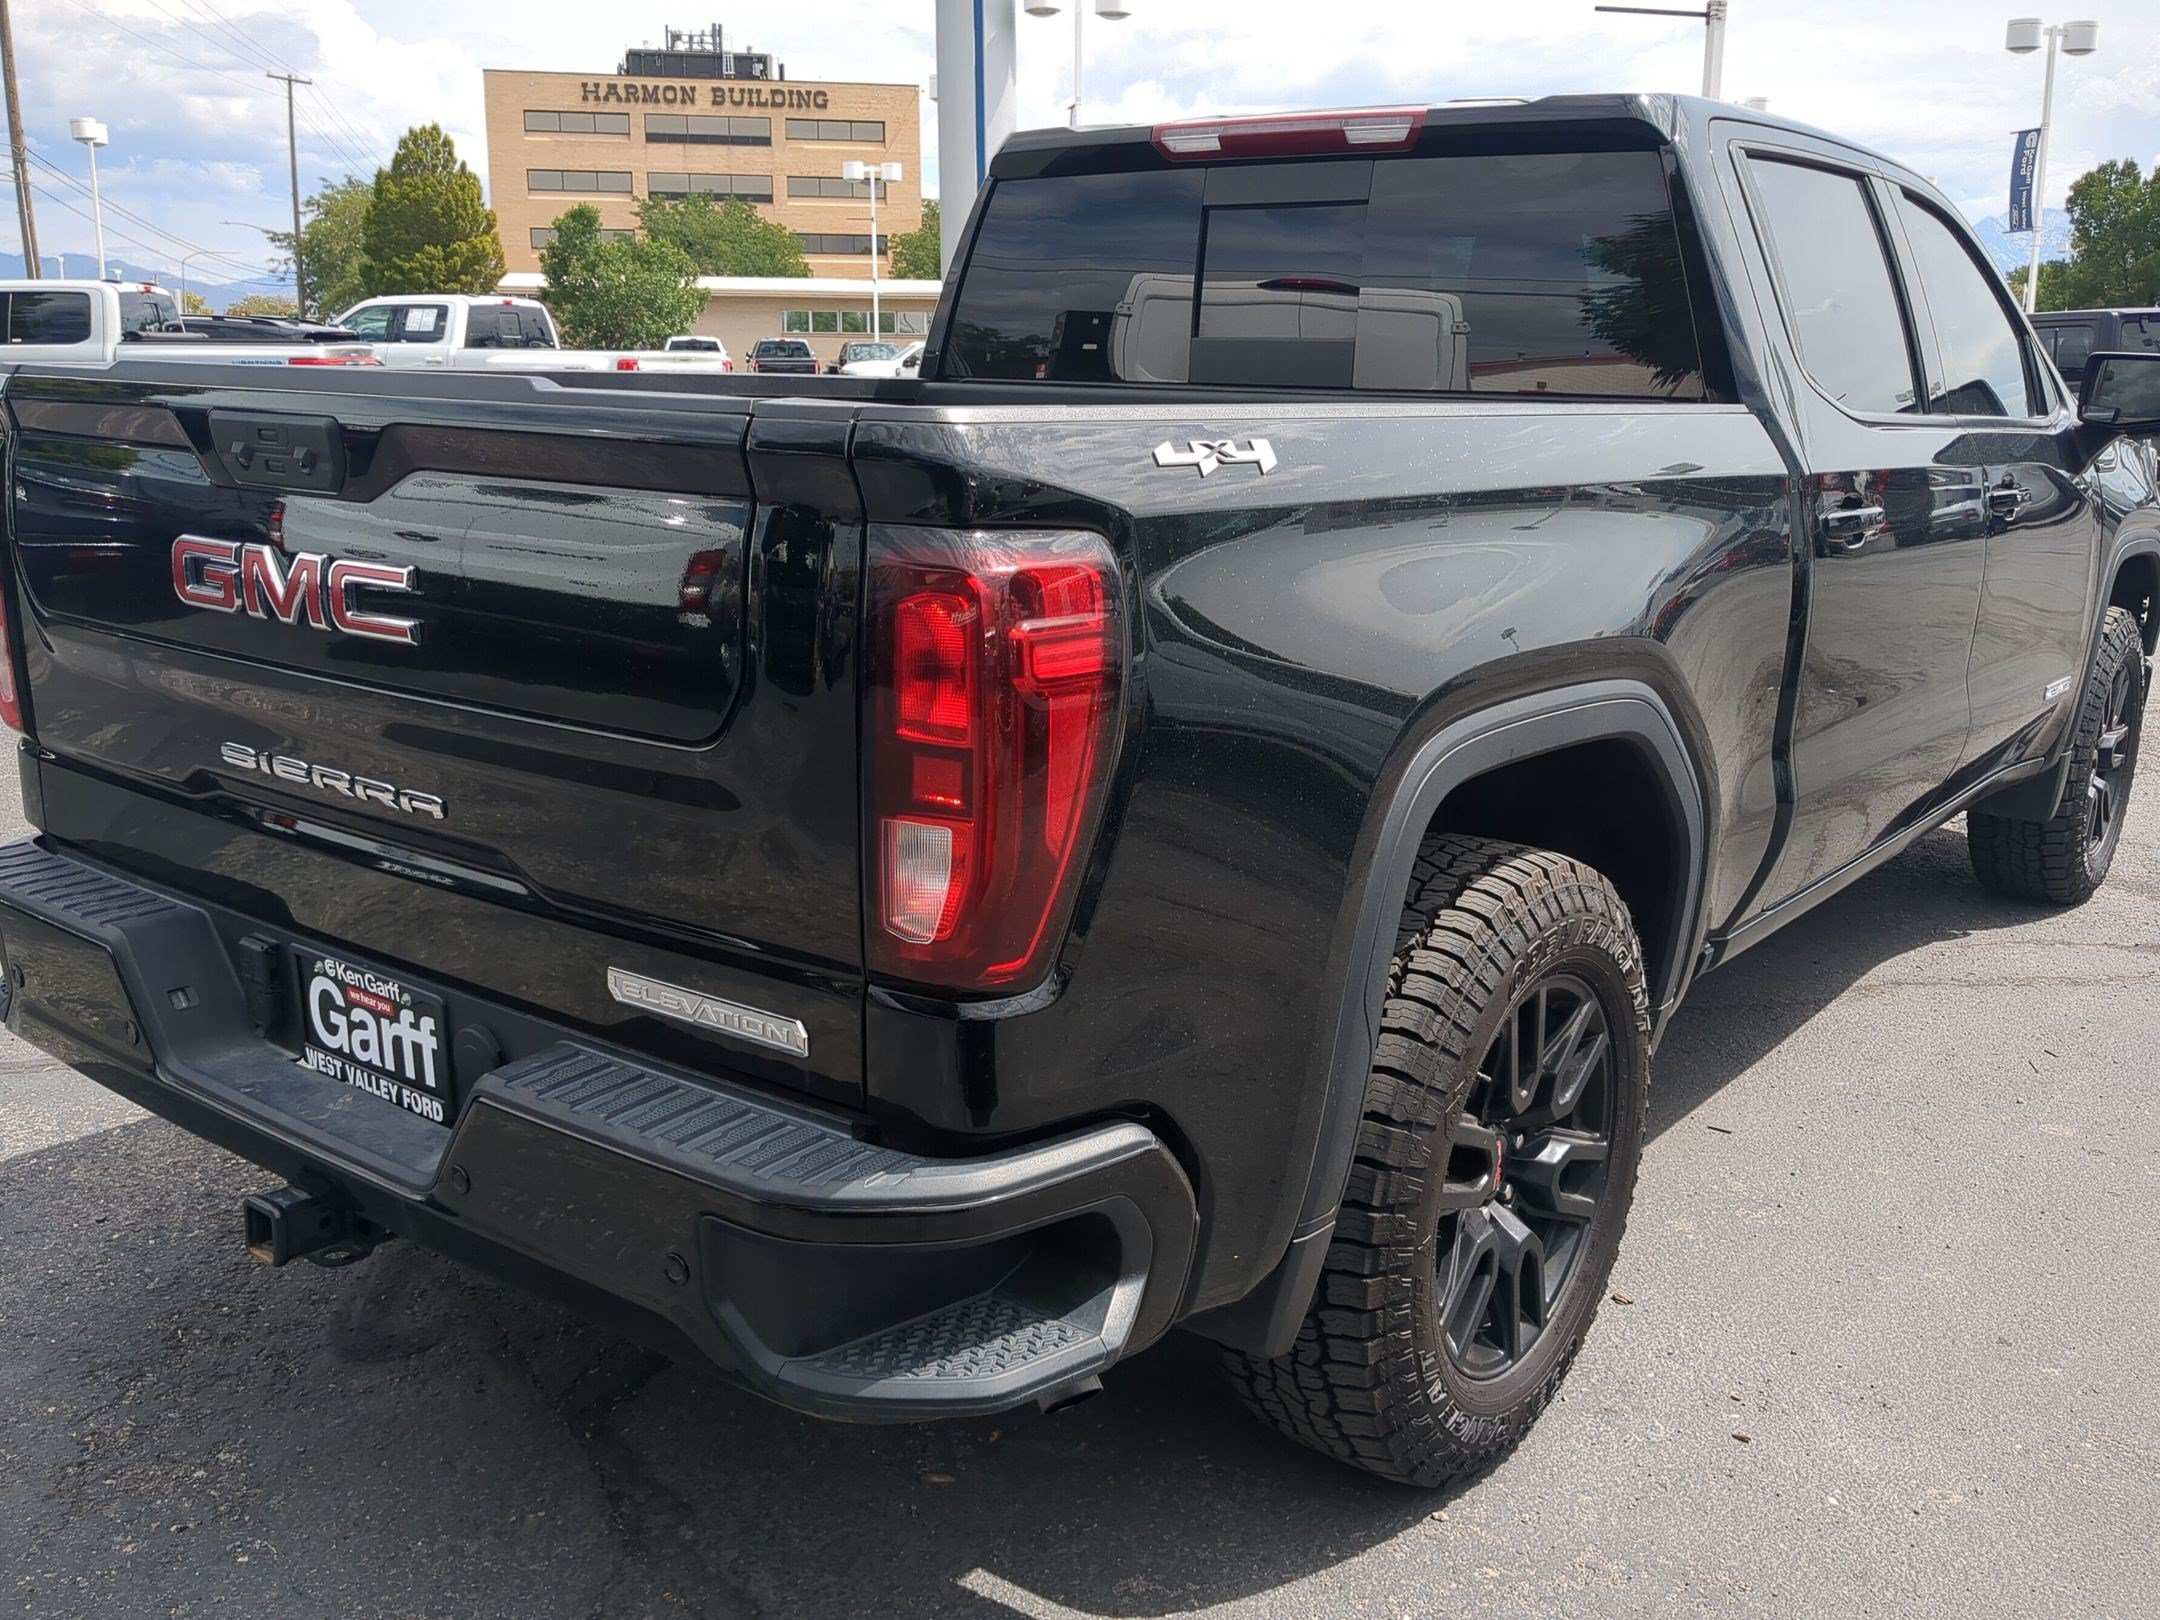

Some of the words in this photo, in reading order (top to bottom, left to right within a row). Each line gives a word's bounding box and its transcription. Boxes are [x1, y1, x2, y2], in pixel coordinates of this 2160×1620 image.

[581, 82, 696, 105] HARMON
[711, 86, 829, 109] BUILDING
[2020, 150, 2029, 176] Ford
[2027, 149, 2035, 164] Ken
[171, 534, 424, 645] GMC
[220, 741, 449, 819] SIERRA
[335, 961, 364, 989] Ken
[364, 974, 400, 1003] Garff
[350, 990, 361, 1000] we
[361, 991, 377, 1008] hear
[377, 1000, 391, 1012] you
[309, 975, 438, 1088] Garff
[622, 979, 790, 1044] ELEVATION
[305, 1046, 343, 1080] WEST
[345, 1062, 399, 1104] VALLEY
[402, 1087, 444, 1123] FORD
